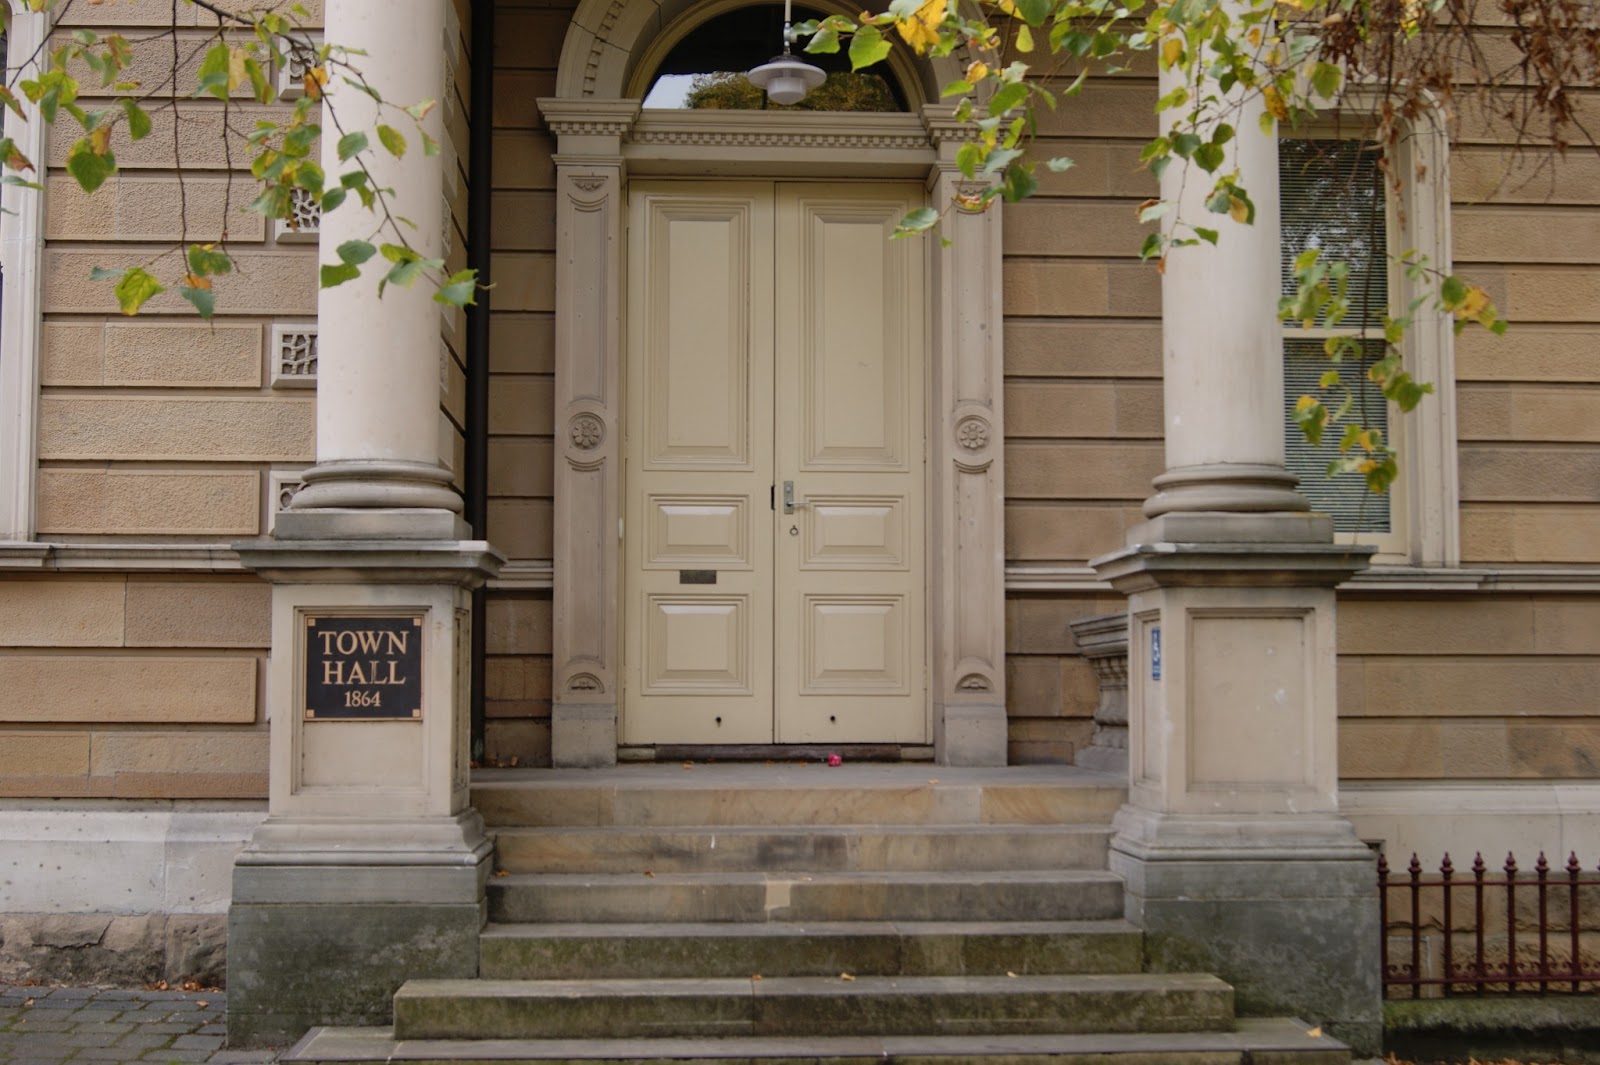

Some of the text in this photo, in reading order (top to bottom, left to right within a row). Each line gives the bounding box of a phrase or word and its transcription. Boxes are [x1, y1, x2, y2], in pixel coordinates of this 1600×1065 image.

[318, 630, 409, 655] TOWN
[322, 660, 406, 685] HALL
[345, 690, 381, 707] 1864
